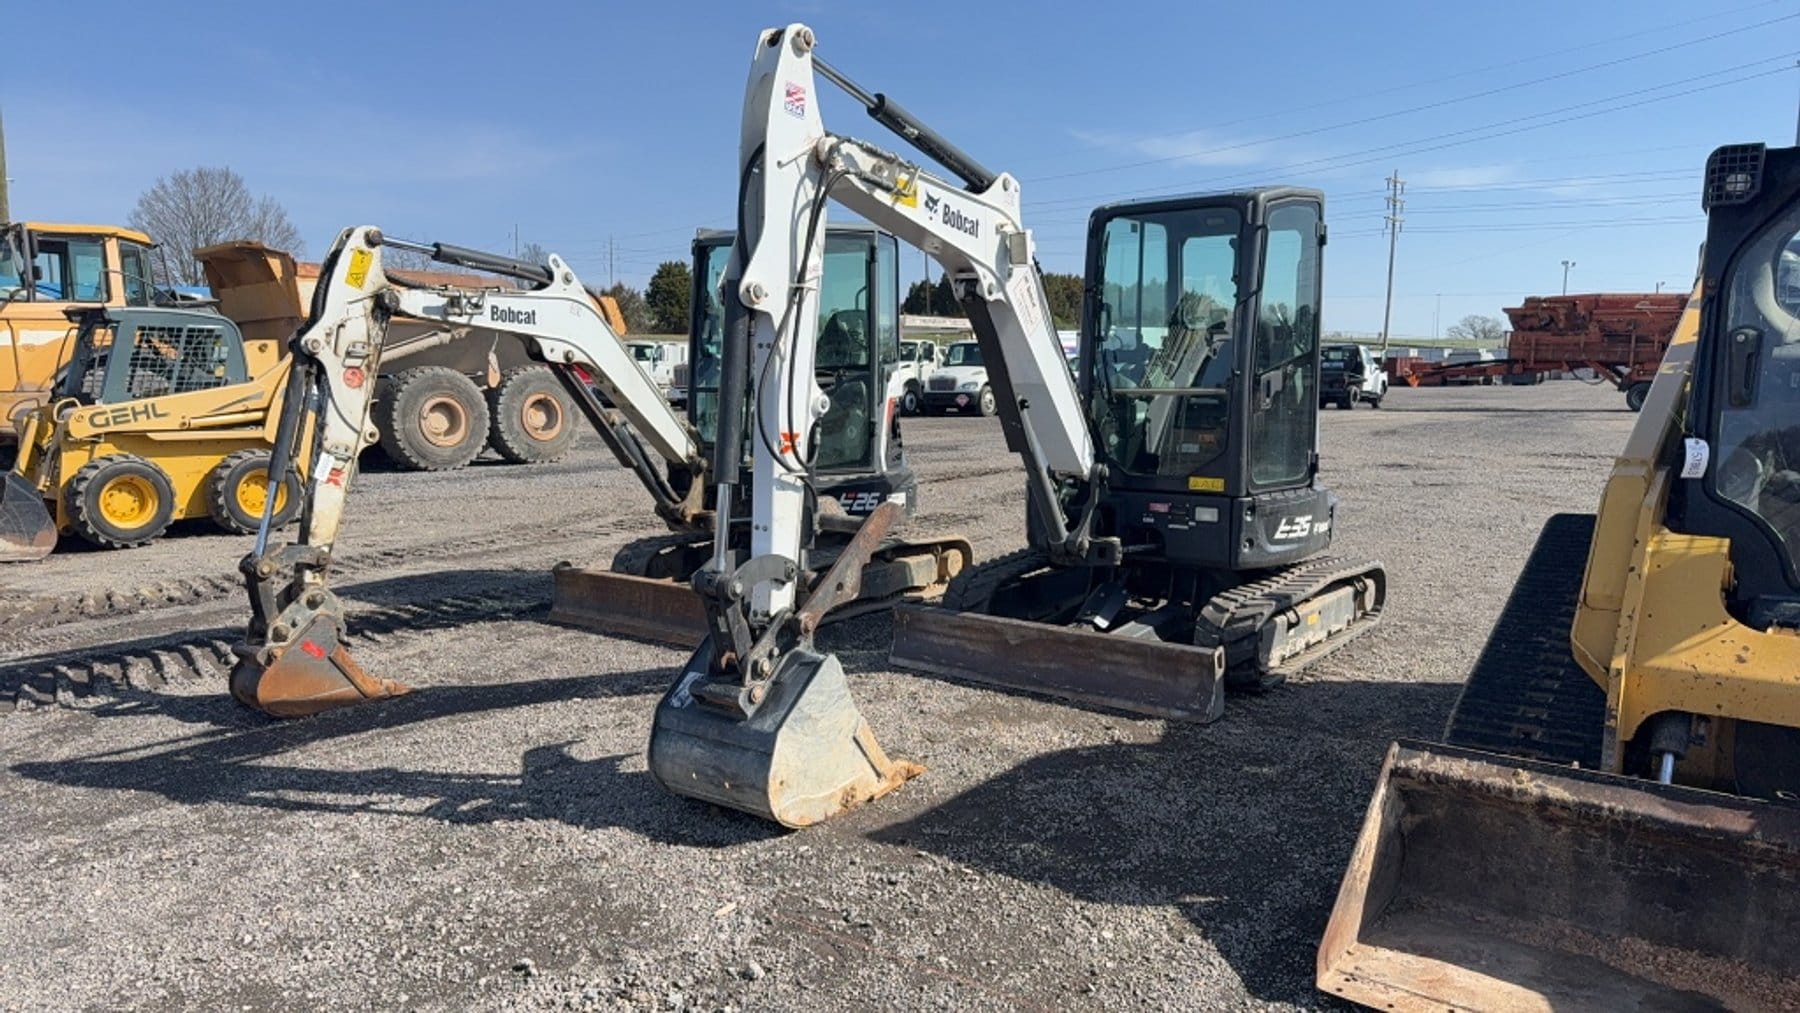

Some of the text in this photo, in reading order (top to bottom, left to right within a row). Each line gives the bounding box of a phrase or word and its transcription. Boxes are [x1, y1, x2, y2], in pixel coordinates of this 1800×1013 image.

[942, 203, 979, 239] Bobcat
[490, 304, 536, 325] Bobcat
[88, 402, 170, 428] GEHL
[839, 492, 880, 511] E26
[1273, 514, 1312, 539] E35
